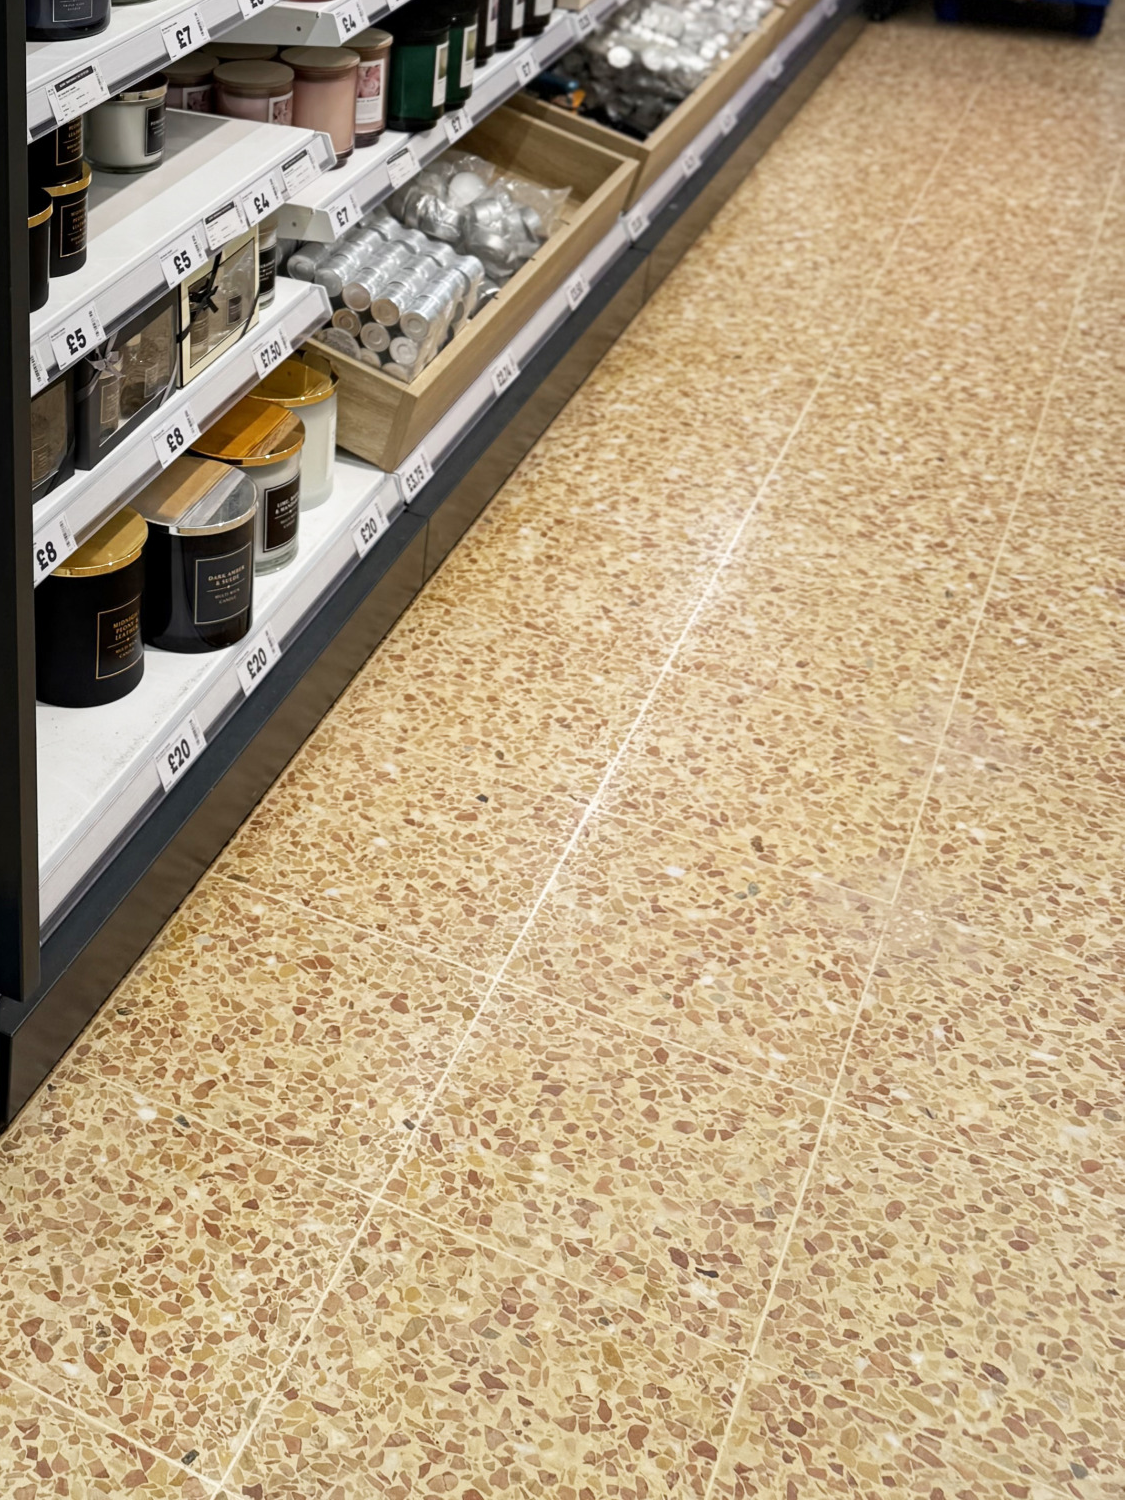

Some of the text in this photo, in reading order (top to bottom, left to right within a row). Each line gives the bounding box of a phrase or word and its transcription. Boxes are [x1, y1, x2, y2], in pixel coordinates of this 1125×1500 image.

[341, 14, 357, 33] £4
[175, 25, 193, 50] £7
[451, 116, 462, 133] £7
[253, 193, 270, 215] £4
[336, 206, 349, 227] £7
[173, 250, 192, 275] £5
[66, 327, 87, 356] £5
[259, 339, 282, 368] £7.50
[166, 427, 185, 453] £8
[405, 464, 426, 493] £3.75
[360, 517, 378, 545] £20
[36, 540, 58, 572] £8
[208, 573, 226, 582] DARK
[246, 647, 268, 680] £20
[166, 738, 191, 775] £20
